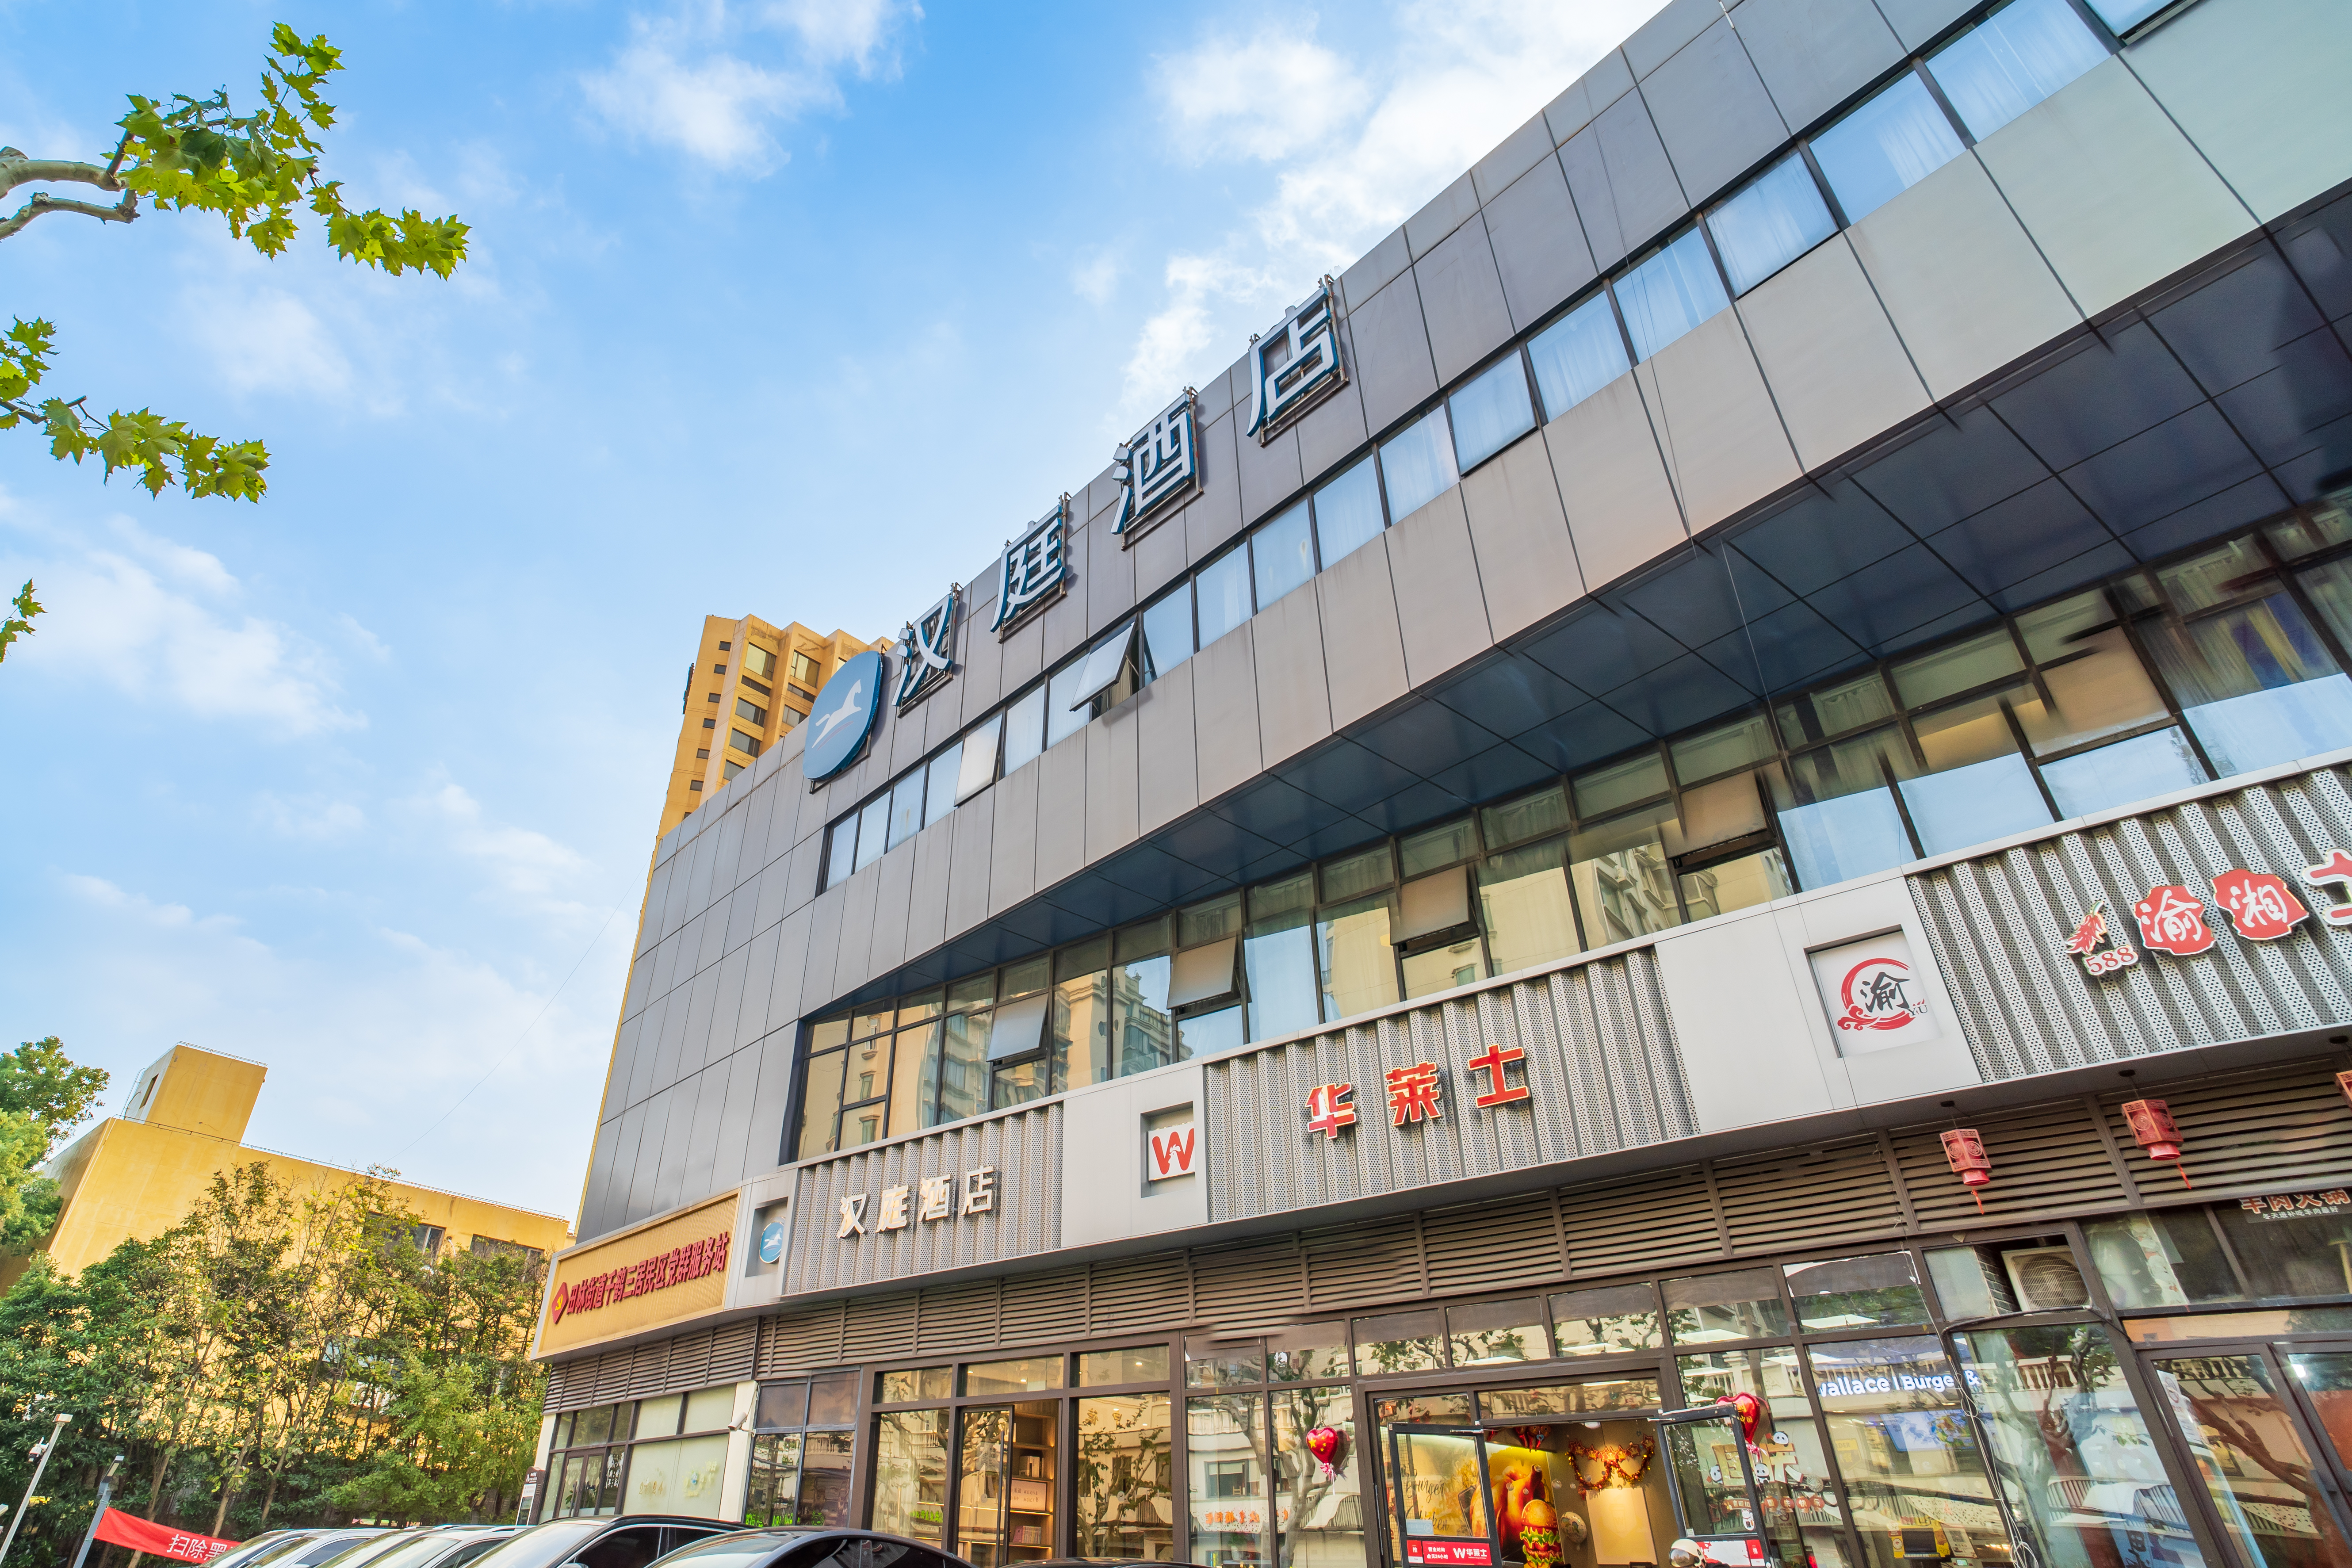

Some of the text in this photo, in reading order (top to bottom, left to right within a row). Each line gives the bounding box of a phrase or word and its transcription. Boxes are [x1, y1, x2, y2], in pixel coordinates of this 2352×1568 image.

[892, 286, 1338, 706] 汉庭酒店
[2084, 945, 2135, 974] 588
[1909, 1004, 1928, 1017] YU
[1305, 1044, 1530, 1139] 华莱士
[1151, 1128, 1195, 1175] W
[836, 1165, 995, 1239] 汉庭酒店
[566, 1231, 730, 1315] 田林街道千鹤三居民区党群服务站
[167, 1534, 233, 1560] 扫除黑
[1466, 1548, 1488, 1557] 华莱士
